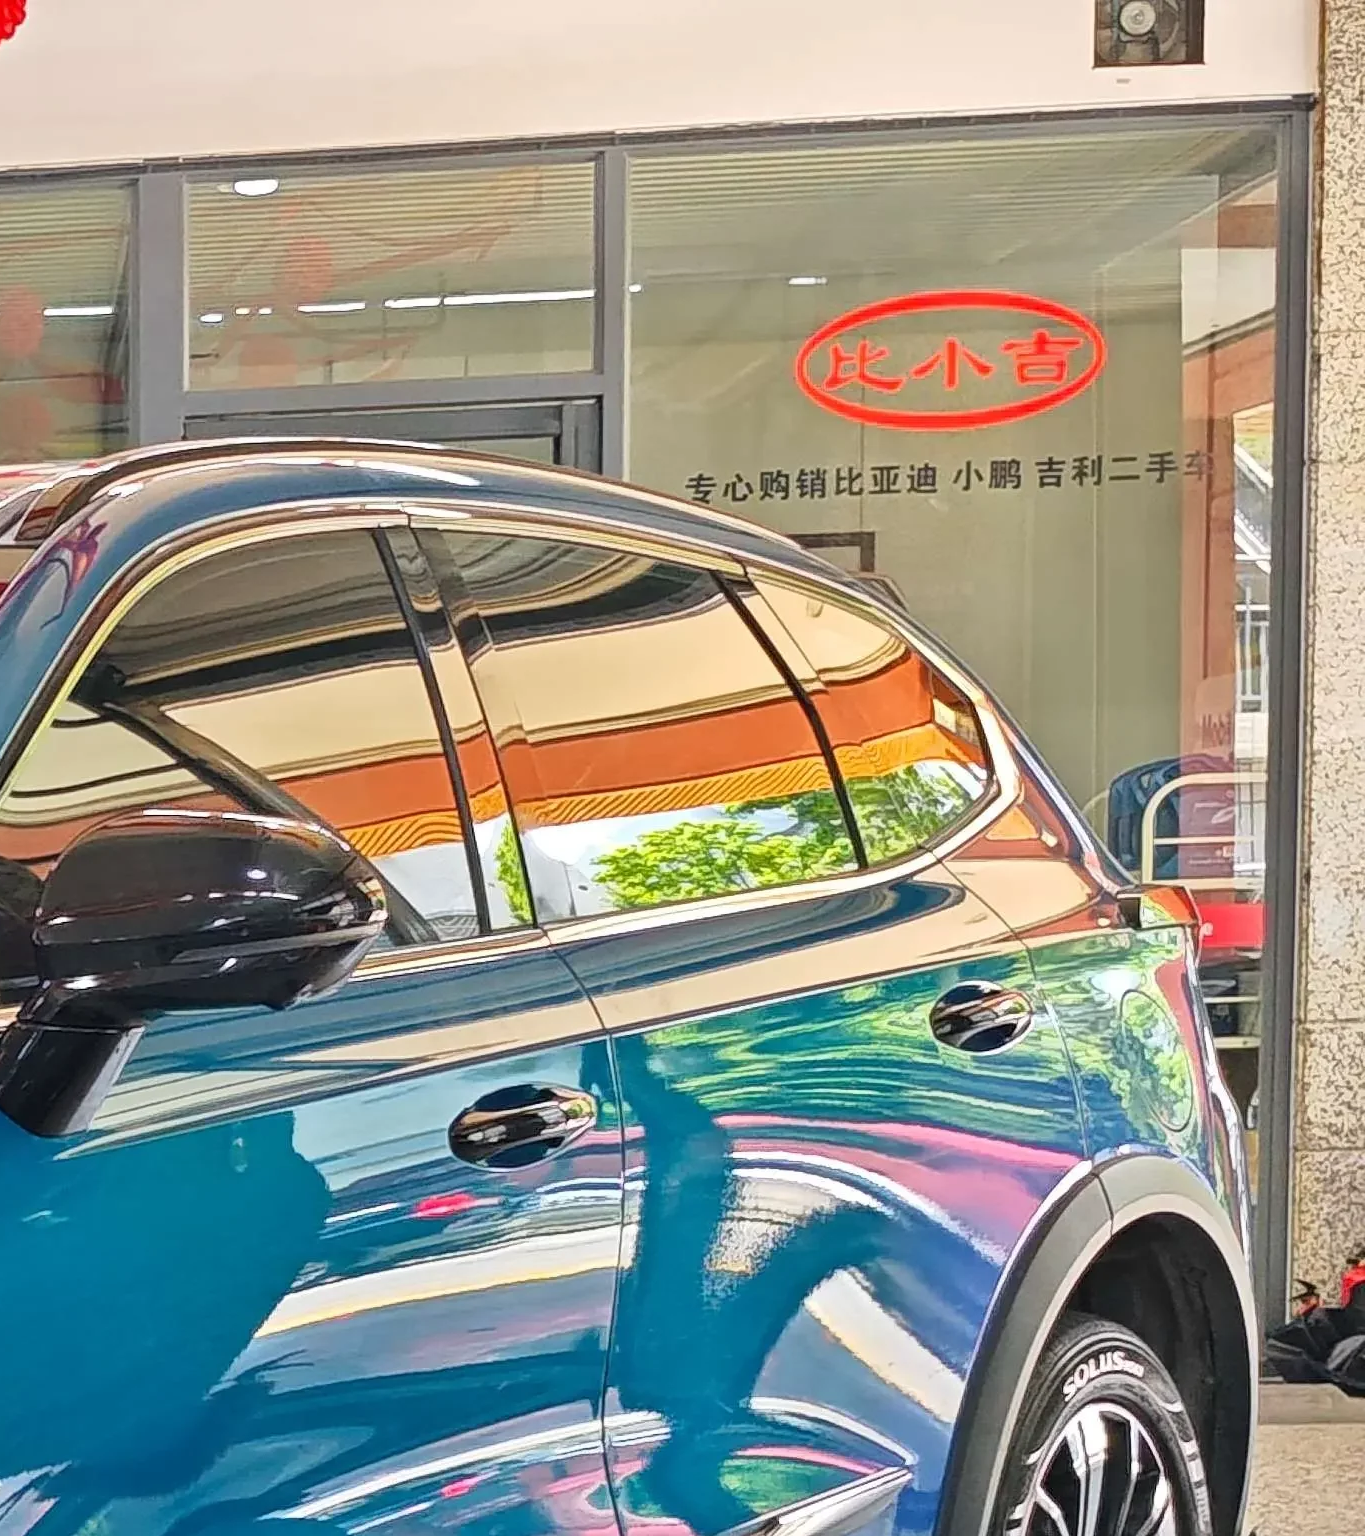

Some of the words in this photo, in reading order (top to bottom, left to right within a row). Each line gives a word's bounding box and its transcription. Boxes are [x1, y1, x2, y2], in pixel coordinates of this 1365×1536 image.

[822, 328, 1082, 393] 比小吉
[685, 462, 938, 504] 专心购销比亚迪
[953, 459, 1022, 491] 小鹏
[1035, 451, 1213, 488] 吉利二手车
[1063, 1351, 1126, 1402] SOLUS
